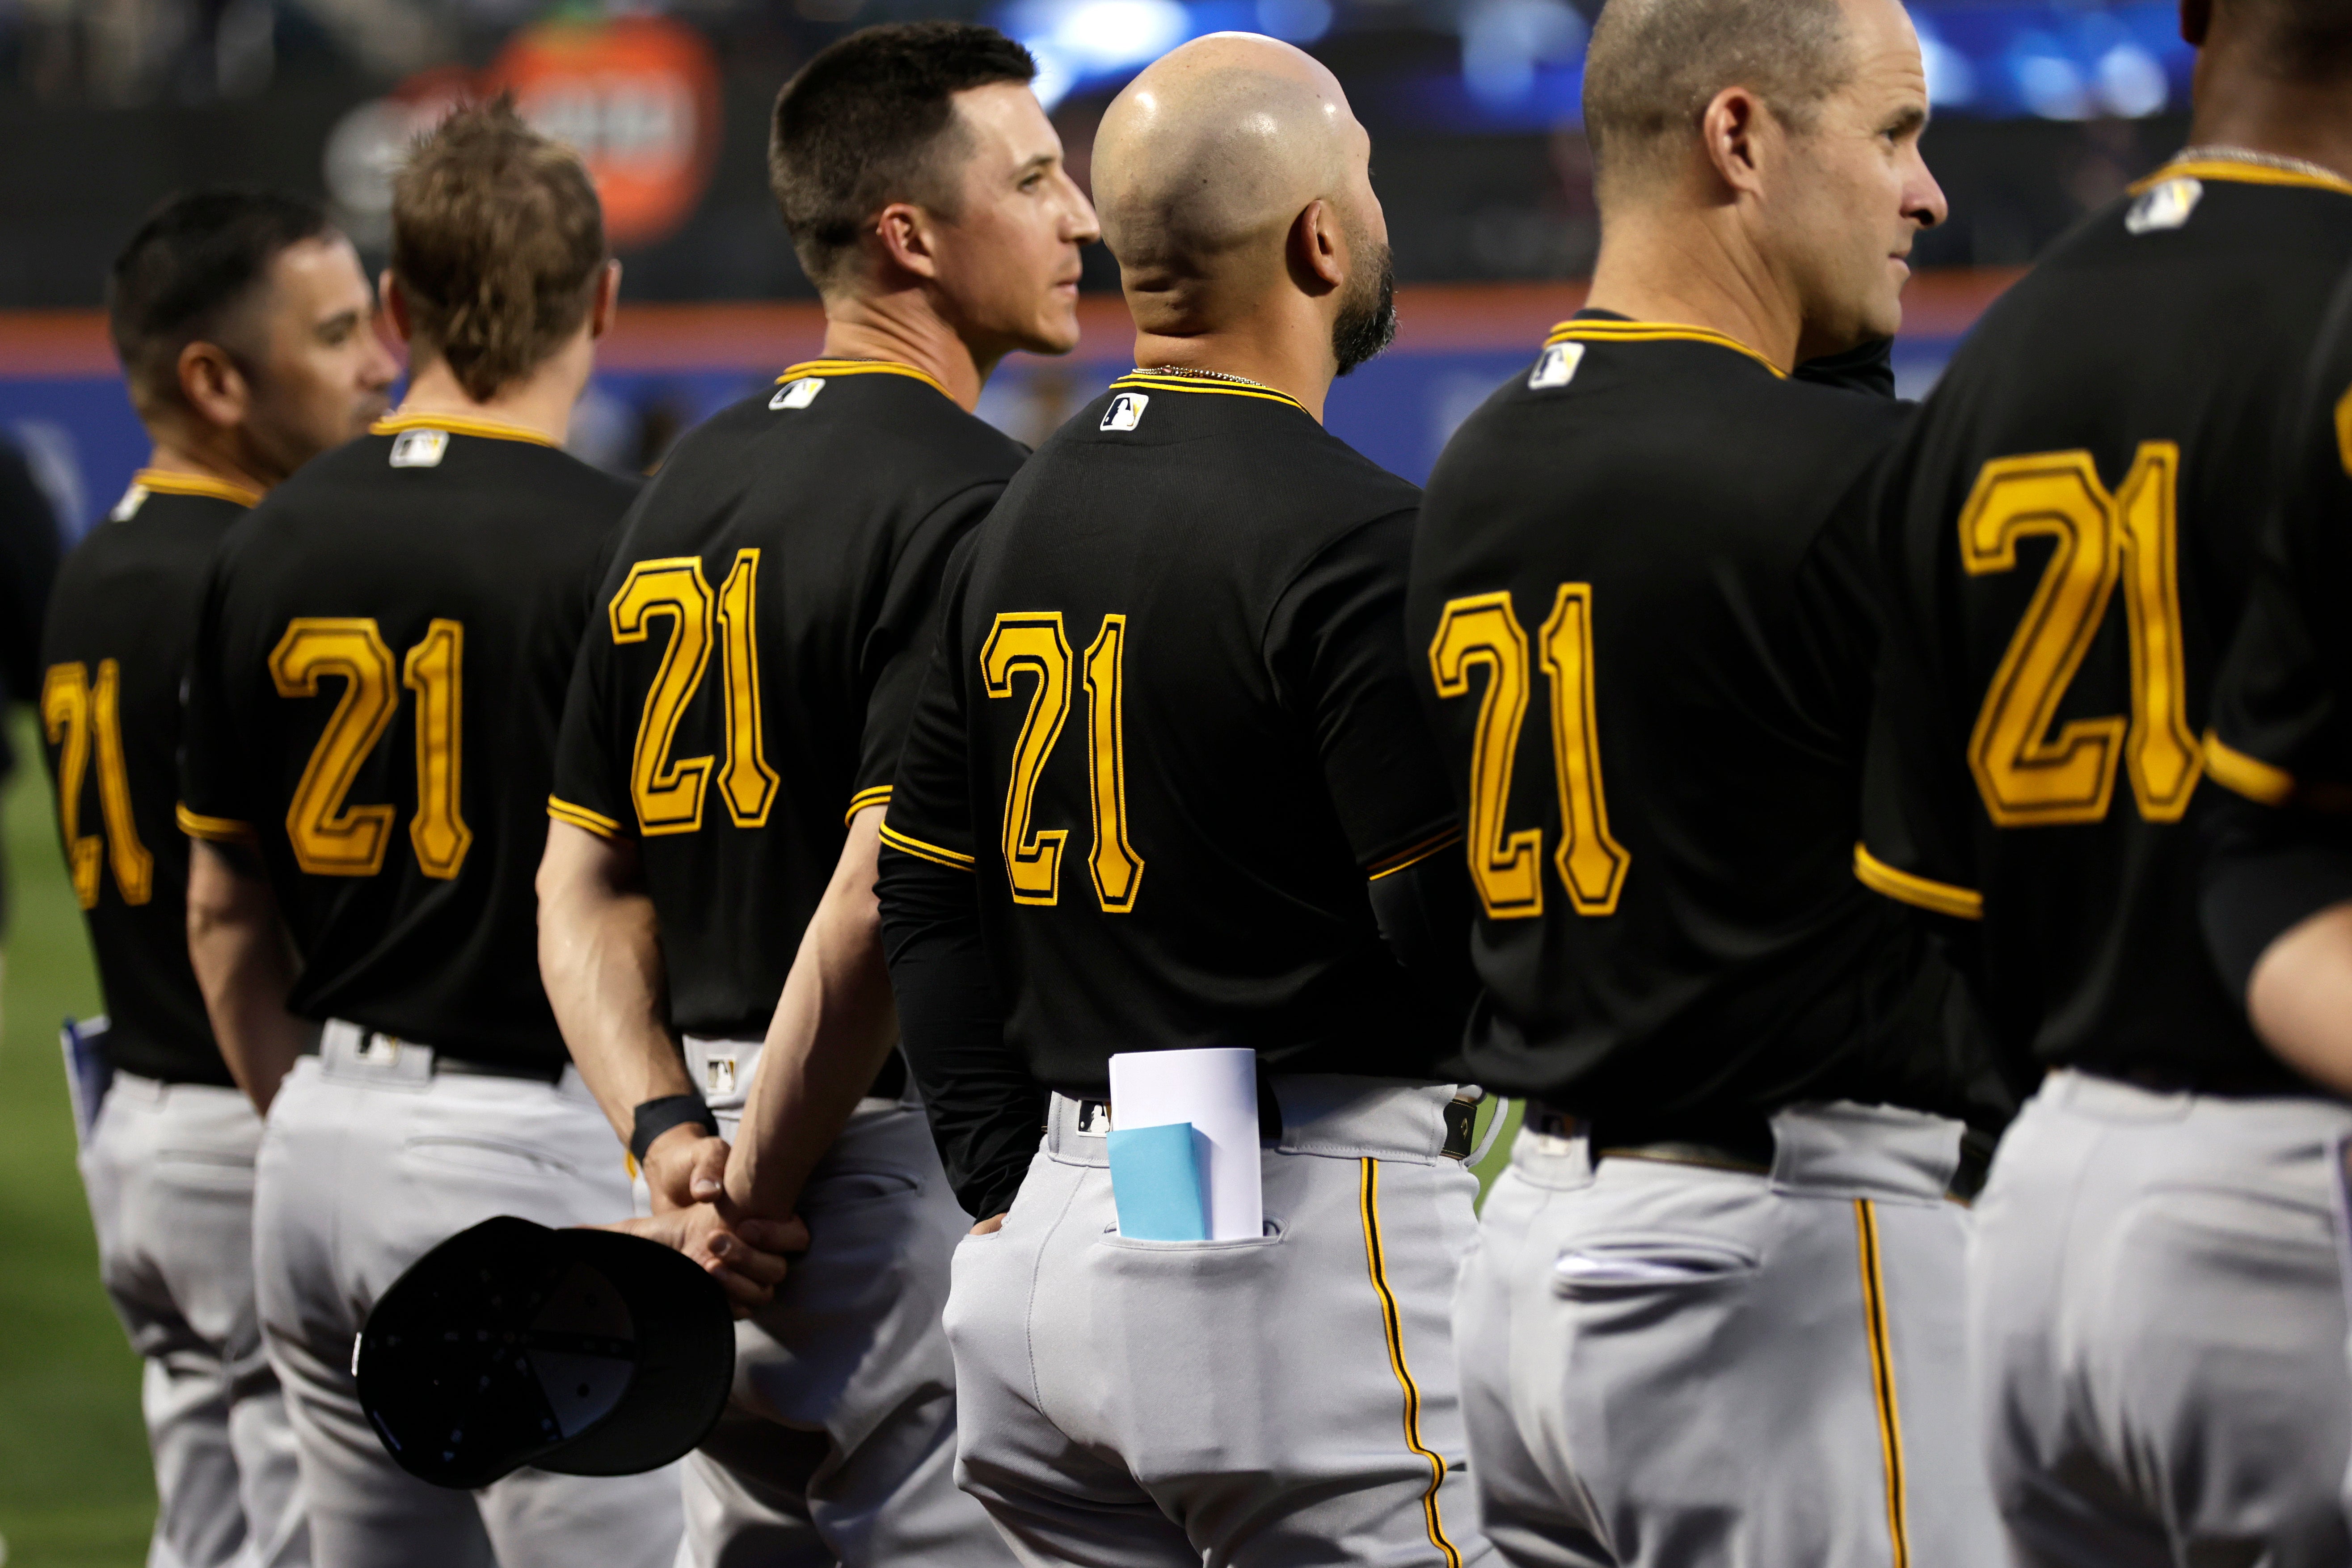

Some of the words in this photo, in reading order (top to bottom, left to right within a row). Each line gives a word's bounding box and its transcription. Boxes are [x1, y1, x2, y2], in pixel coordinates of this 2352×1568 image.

[268, 617, 473, 879] 21
[608, 547, 781, 838] 21
[979, 611, 1146, 913] 21
[1428, 582, 1631, 920] 21
[1957, 439, 2204, 829] 21
[42, 658, 153, 910] 21
